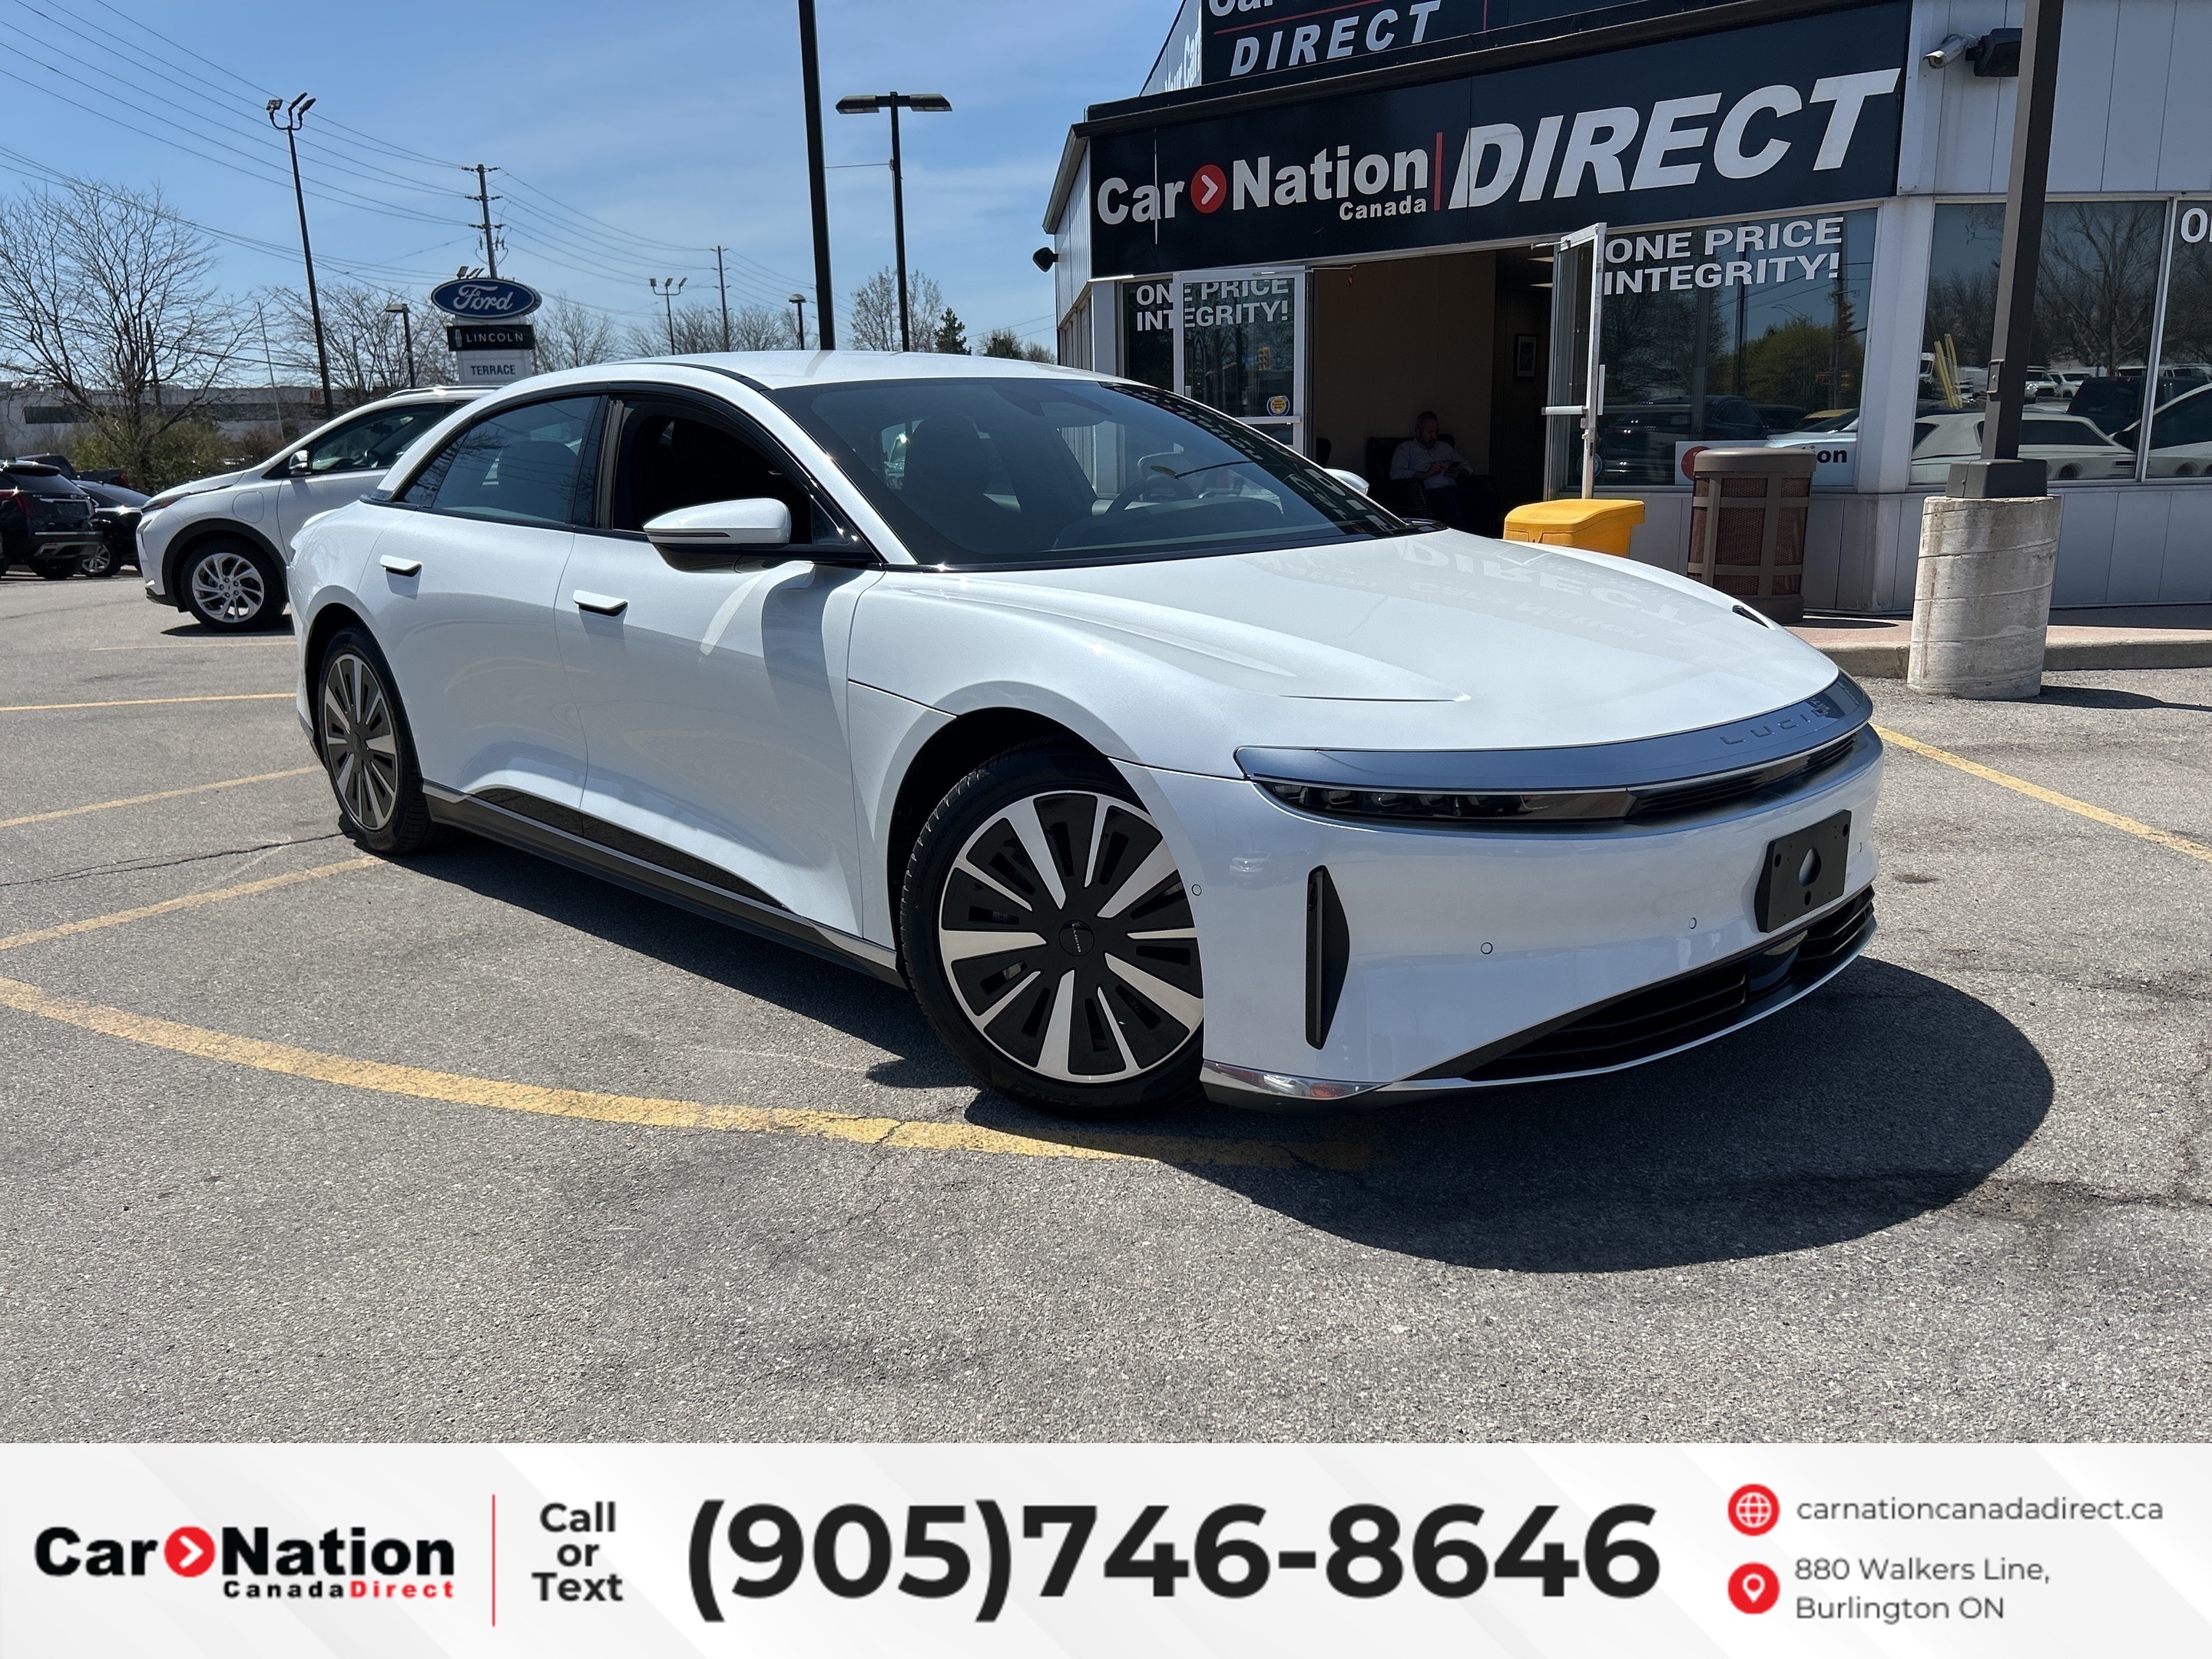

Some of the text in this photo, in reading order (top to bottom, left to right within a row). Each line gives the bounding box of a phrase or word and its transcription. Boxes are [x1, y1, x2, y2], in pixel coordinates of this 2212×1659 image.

[1230, 1, 1440, 76] DIRECT
[1098, 68, 1901, 224] Car Nation DIRECT
[1339, 195, 1426, 220] Canada
[1605, 217, 1843, 263] ONE PRICE
[1604, 252, 1839, 296] INTEGRITY!
[453, 284, 514, 310] Ford
[1200, 280, 1289, 300] PRICE
[1137, 300, 1288, 331] INTEGRITY!
[466, 333, 524, 343] LINCOLN
[471, 365, 515, 375] TERRACE
[1720, 707, 1829, 744] LUCID
